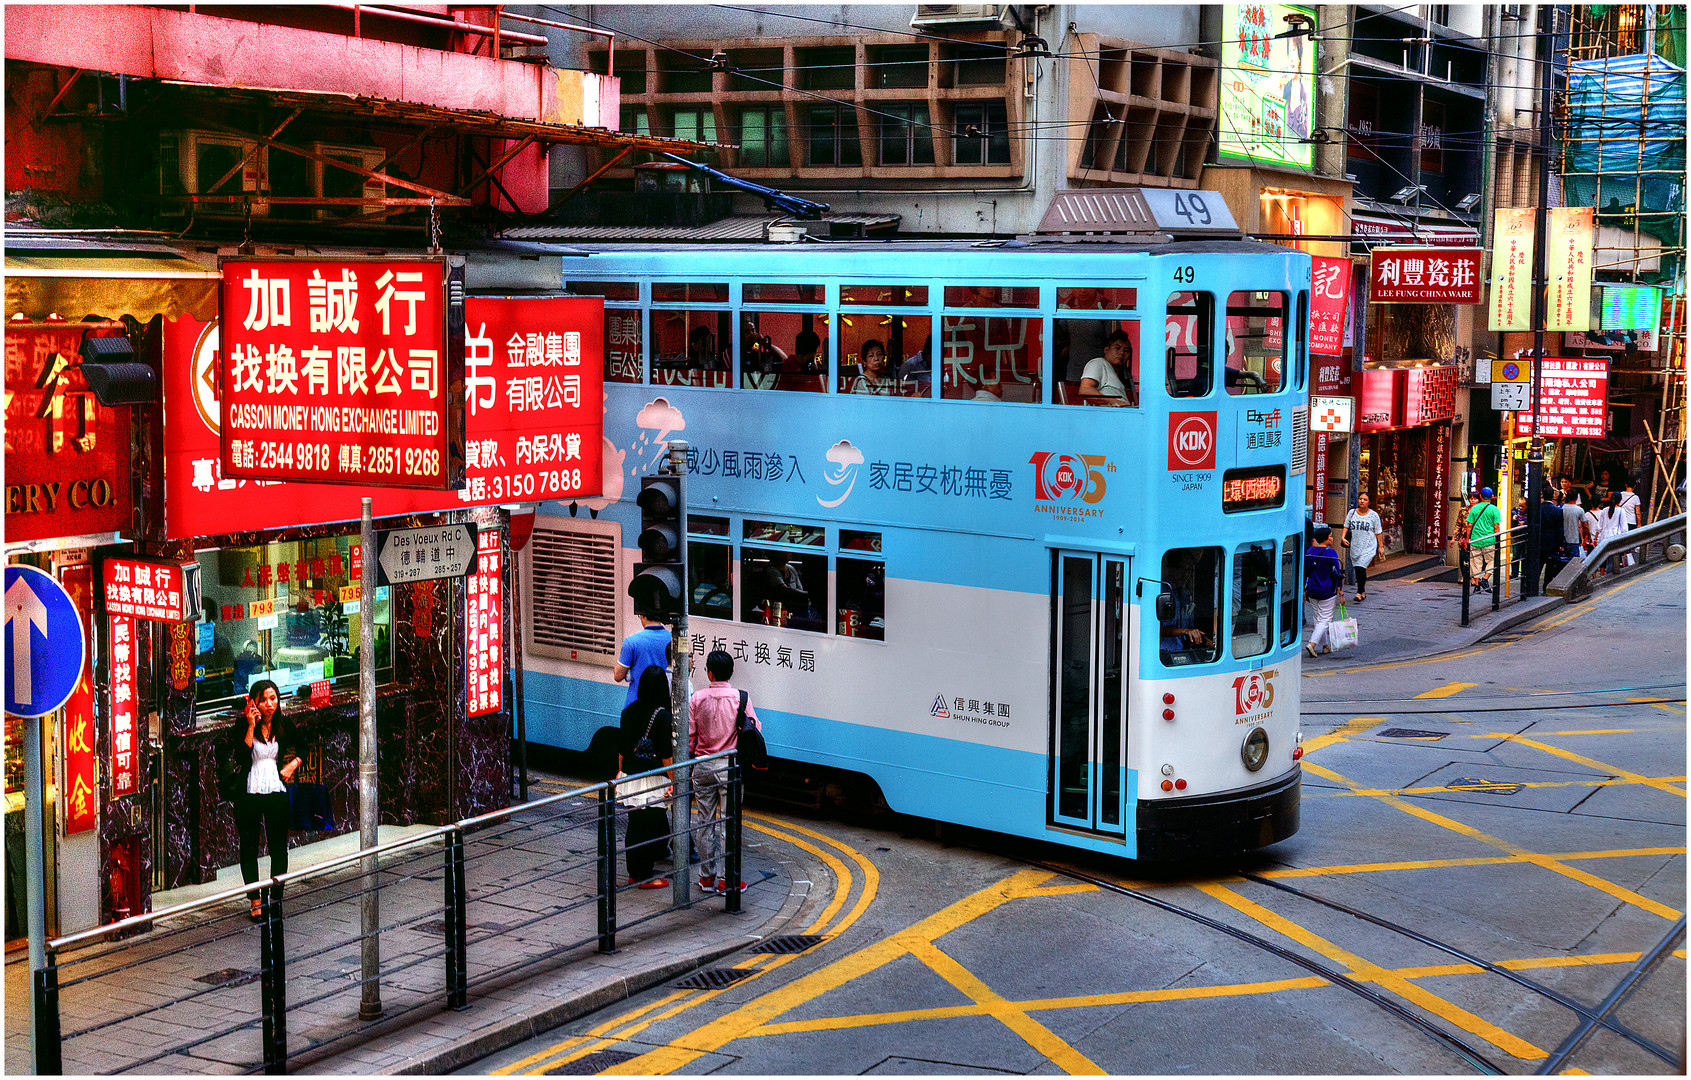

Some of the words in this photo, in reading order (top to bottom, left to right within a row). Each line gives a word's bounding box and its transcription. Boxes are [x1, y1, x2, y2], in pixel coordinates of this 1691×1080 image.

[1174, 192, 1212, 225] 49
[1173, 265, 1195, 284] 49
[1313, 261, 1344, 300] 記
[1377, 257, 1475, 288] 利豐瓷莊
[242, 267, 426, 336] 加誠行
[1378, 289, 1394, 298] LEE
[1396, 289, 1419, 298] FUNG
[1420, 289, 1447, 298] CHINA
[1448, 290, 1473, 298] WARE
[505, 330, 581, 368] 金融集團
[1313, 334, 1339, 343] MONEY
[505, 374, 581, 412] 有限公司
[1516, 384, 1523, 395] 7
[1516, 399, 1523, 409] 7
[230, 403, 272, 430] CASSON
[273, 404, 311, 431] MONEY
[311, 406, 341, 433] HONG
[341, 407, 398, 435] EXCHANGE
[399, 409, 439, 436] LIMITED
[1179, 430, 1208, 452] KDK
[296, 442, 330, 471] 9818
[405, 447, 440, 477] 9268
[1106, 461, 1118, 473] th
[538, 468, 582, 494] 7888
[868, 459, 1014, 501] 家居安枕無憂
[1058, 471, 1073, 483] KDK
[1171, 473, 1194, 484] SINCE
[1196, 472, 1212, 483] 1909
[1181, 482, 1203, 492] JAPAN
[70, 478, 118, 509] CO.
[1034, 504, 1105, 518] ANNIVERSARY
[393, 535, 411, 548] Des
[412, 532, 439, 545] Voeux
[441, 529, 453, 542] Rd
[454, 528, 463, 541] C
[400, 544, 455, 566] 德輔道中
[113, 562, 172, 589] 加誠行
[341, 587, 361, 601] 795
[106, 601, 122, 613] CASSON
[121, 603, 135, 614] MONEY
[146, 605, 166, 619] EXCHANGE
[165, 608, 181, 621] LIMITED
[251, 601, 273, 617] 793
[953, 696, 1011, 719] 信興集團
[1234, 710, 1274, 726] ANNIVERSARY
[953, 713, 971, 723] SHUN
[971, 717, 988, 726] HING
[988, 719, 1011, 729] GROUP
